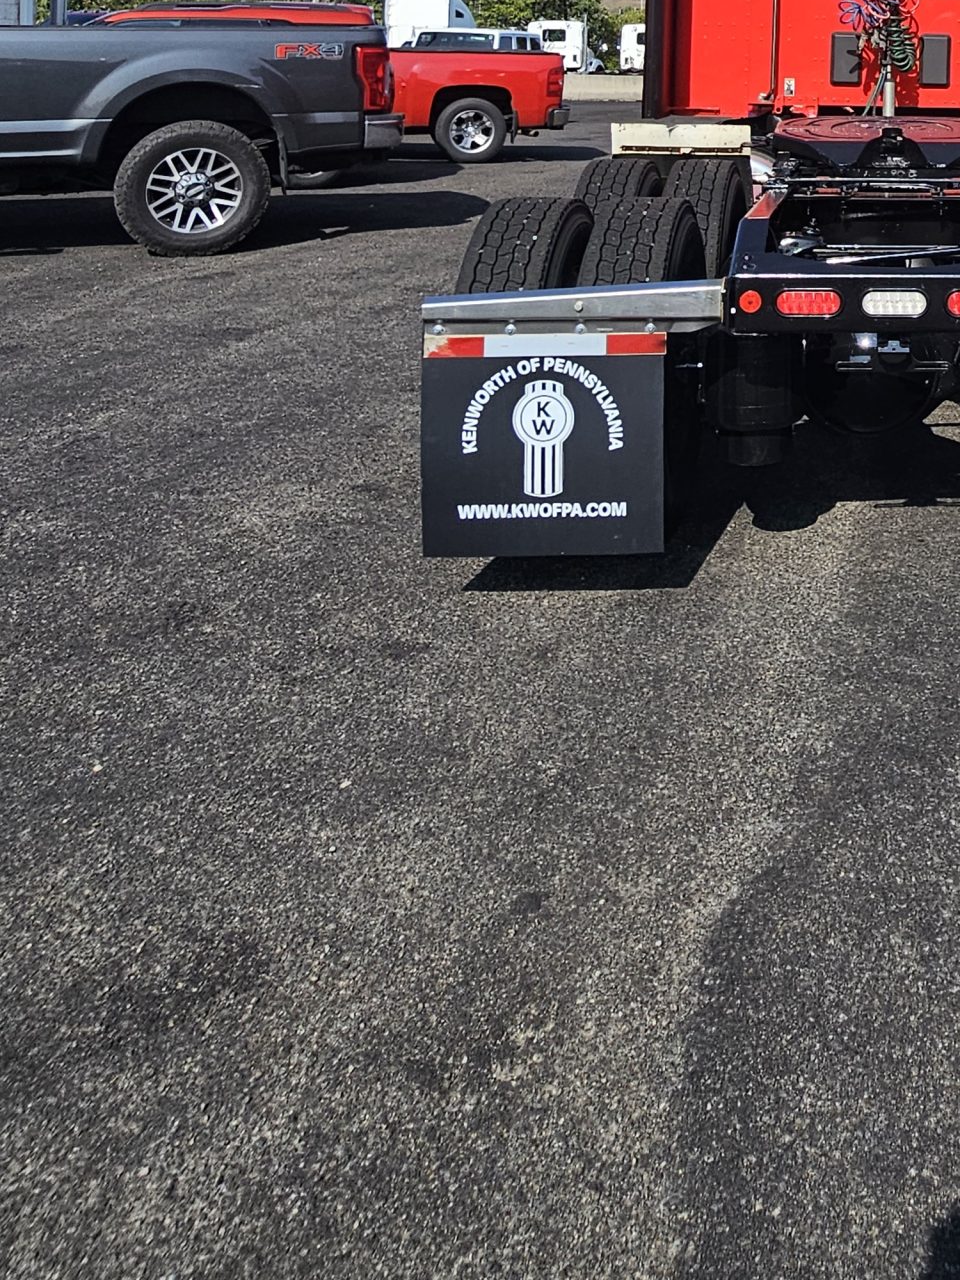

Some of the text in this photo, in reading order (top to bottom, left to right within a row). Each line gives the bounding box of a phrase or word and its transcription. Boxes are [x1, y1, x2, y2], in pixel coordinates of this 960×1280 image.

[274, 43, 344, 60] FX4
[462, 358, 625, 454] KENWORTH OF PENNSYLVANIA
[457, 502, 627, 519] WWW.KWOFPA.COM
